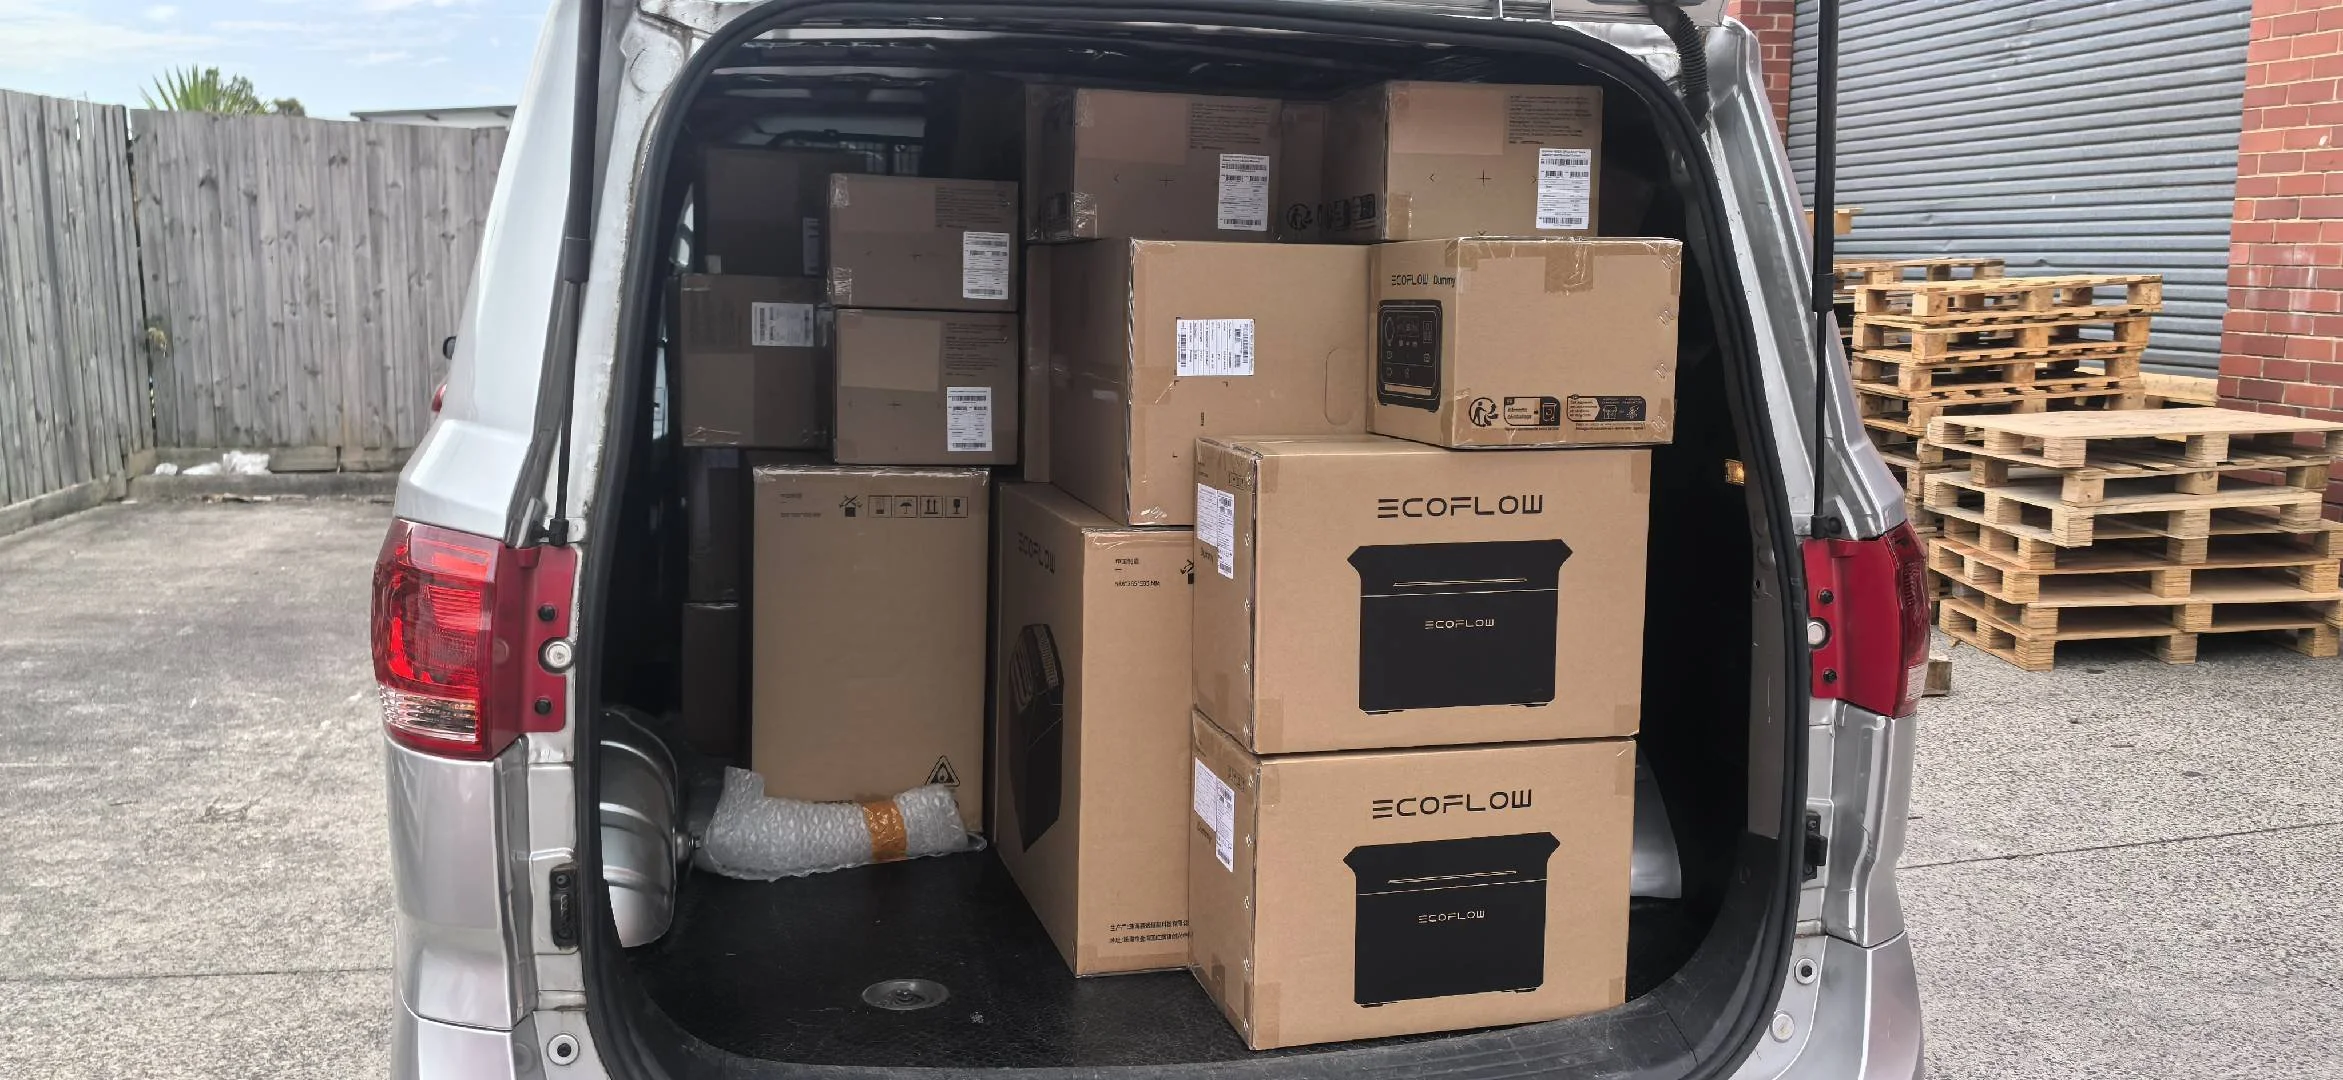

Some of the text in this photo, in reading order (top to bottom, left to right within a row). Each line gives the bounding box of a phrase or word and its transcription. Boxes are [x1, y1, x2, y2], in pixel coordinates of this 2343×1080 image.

[1391, 274, 1457, 288] ECOFLOW Dummy
[1378, 495, 1543, 518] ECOFLOW
[1017, 531, 1056, 575] ECOFLOW
[1424, 619, 1495, 630] ECOFLOW
[1372, 789, 1533, 820] ECOFLOW
[1418, 910, 1485, 923] ECOFLOW
